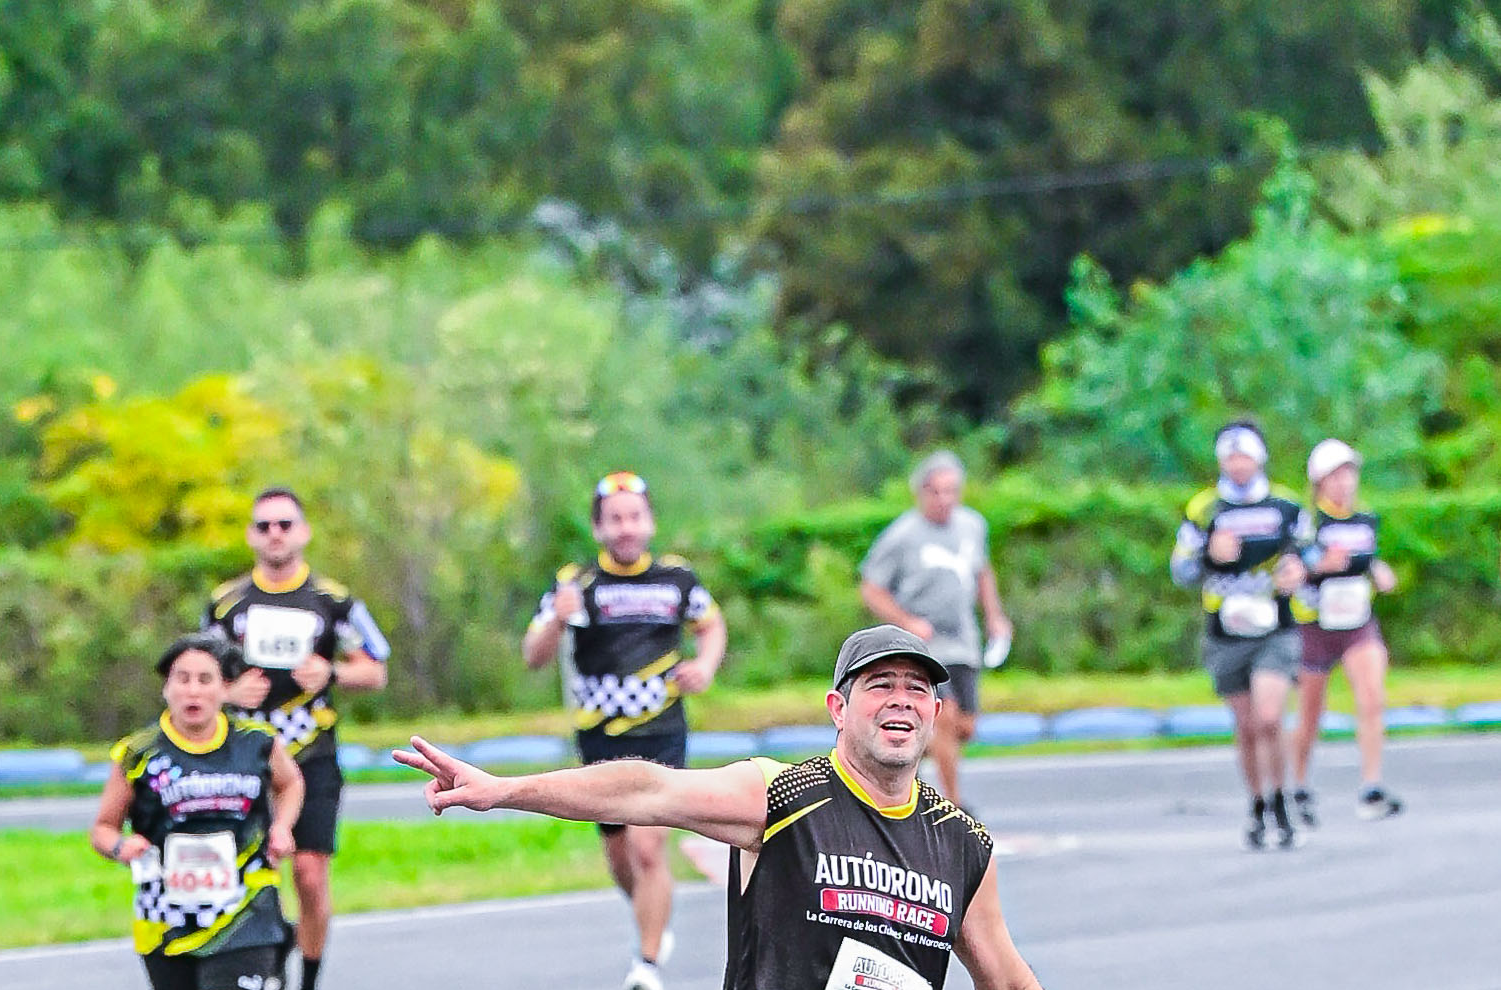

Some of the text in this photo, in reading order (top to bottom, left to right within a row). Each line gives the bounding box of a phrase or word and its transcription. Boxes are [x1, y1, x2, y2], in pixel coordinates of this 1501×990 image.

[814, 851, 953, 914] AUTÓDROMO
[806, 910, 817, 921] La
[818, 912, 852, 928] Carrera
[853, 920, 864, 931] de
[865, 920, 878, 933] los
[903, 931, 919, 944] del
[837, 892, 936, 931] RUNNING RACE
